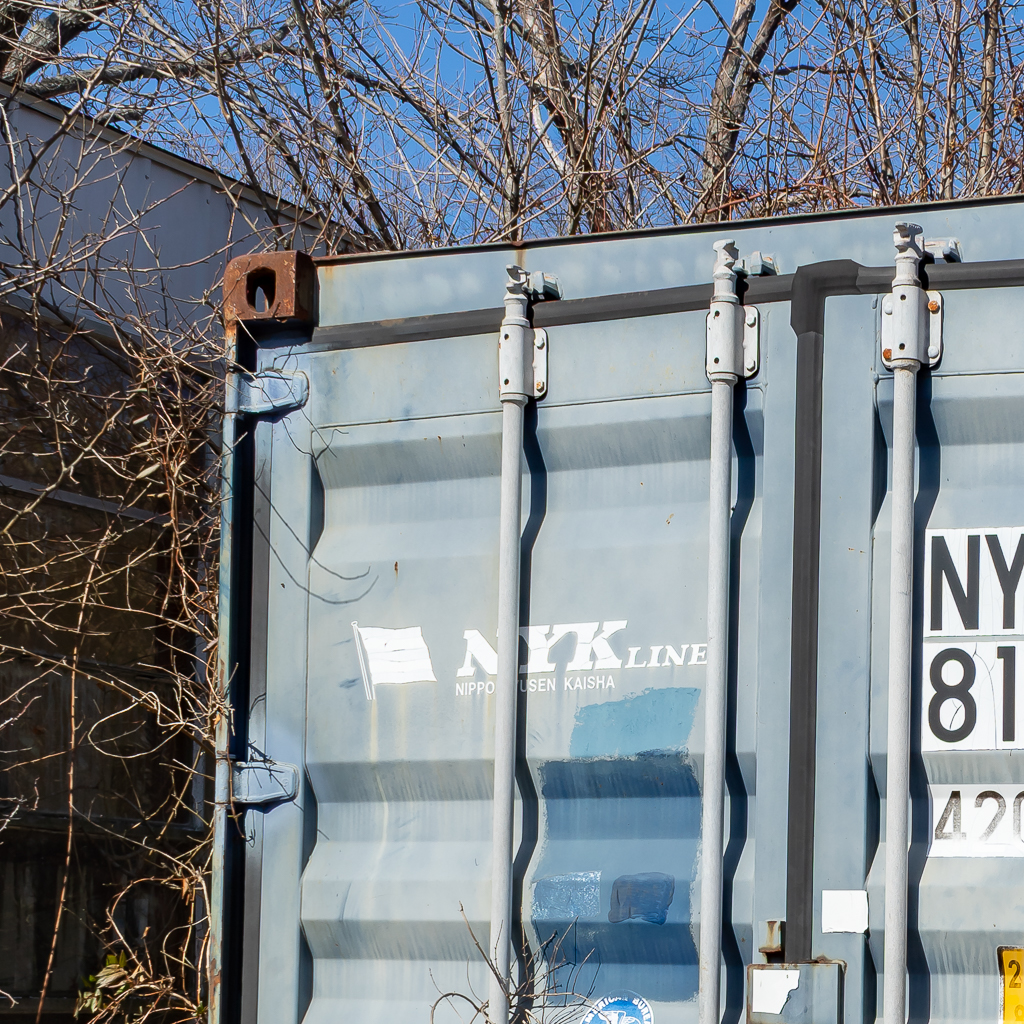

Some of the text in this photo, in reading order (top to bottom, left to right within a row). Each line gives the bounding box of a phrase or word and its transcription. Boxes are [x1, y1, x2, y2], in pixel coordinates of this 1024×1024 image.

[624, 643, 708, 668] LINE
[455, 681, 496, 696] NIPPO
[563, 674, 616, 691] KAISHA
